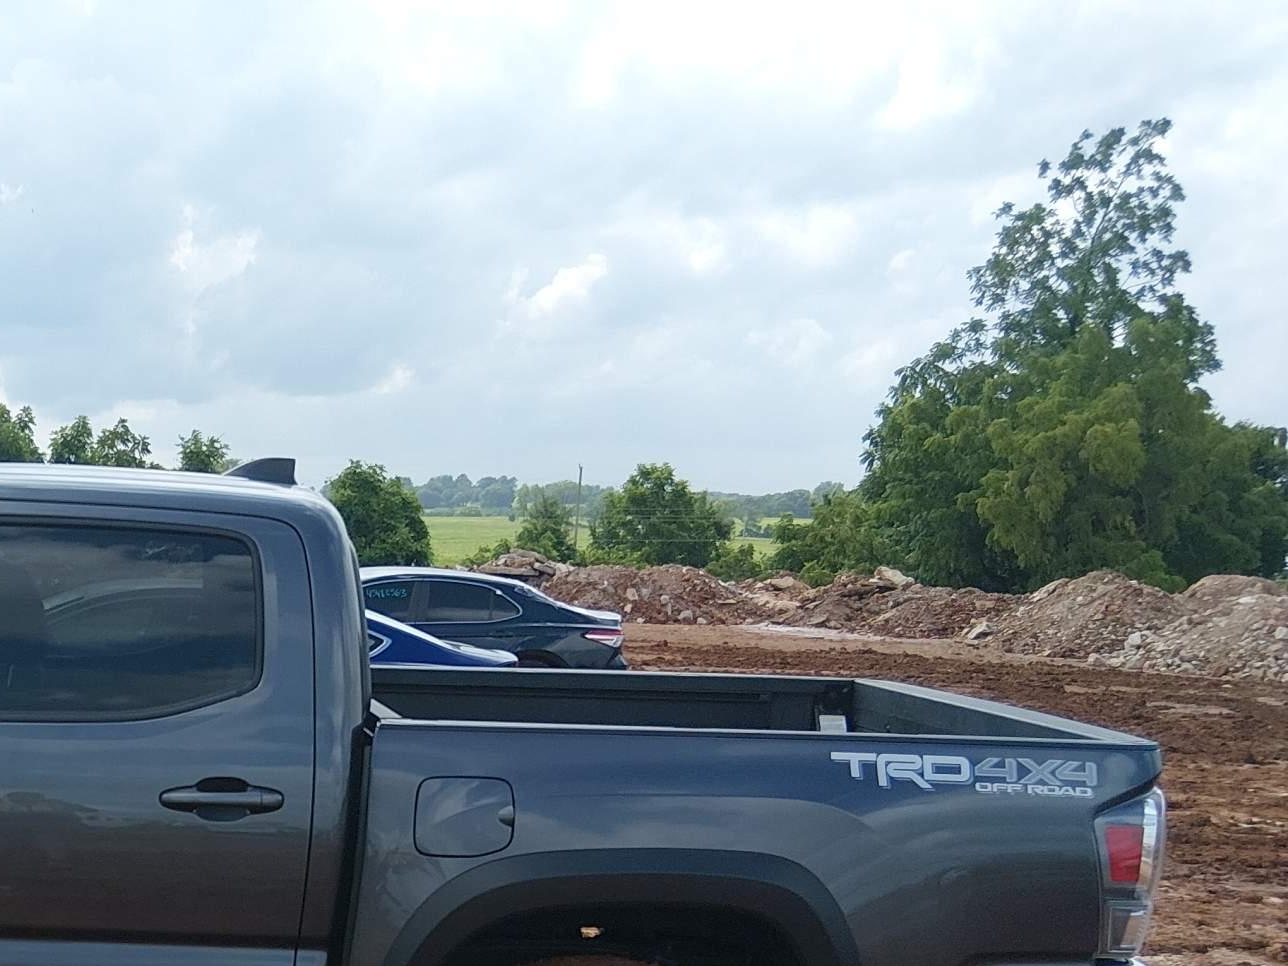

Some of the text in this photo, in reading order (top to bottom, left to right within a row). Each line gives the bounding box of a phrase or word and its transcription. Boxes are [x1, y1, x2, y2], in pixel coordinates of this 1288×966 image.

[830, 751, 1098, 790] TRD 4X4
[975, 782, 1094, 799] OFF ROAD
